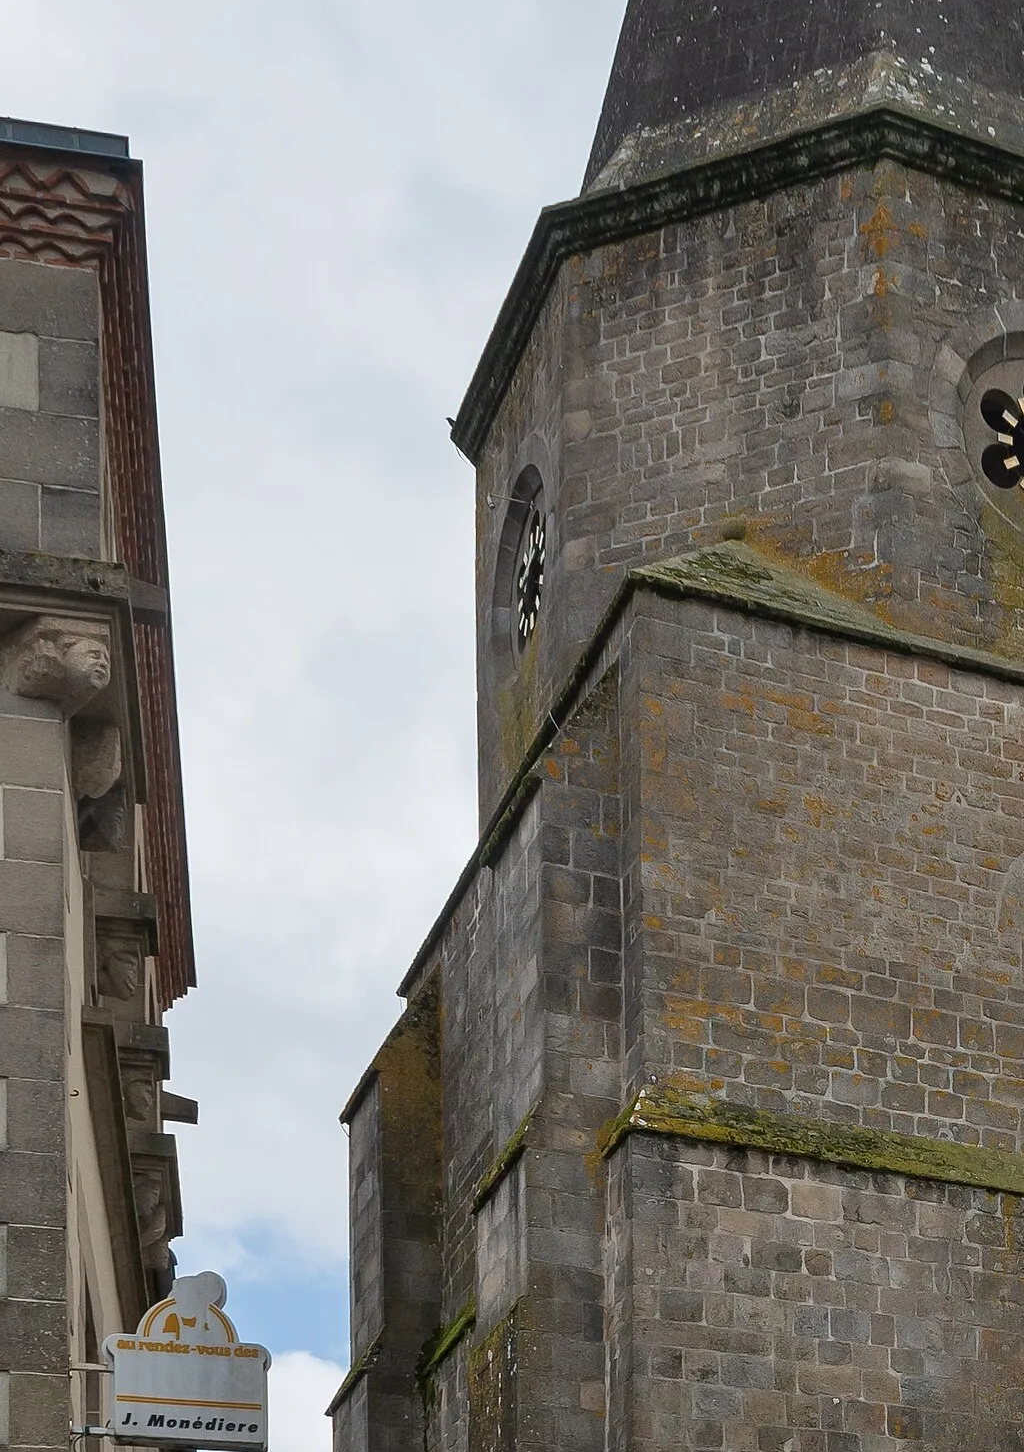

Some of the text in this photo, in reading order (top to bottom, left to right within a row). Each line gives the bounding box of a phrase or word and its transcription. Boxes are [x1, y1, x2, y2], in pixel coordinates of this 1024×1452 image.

[116, 1339, 259, 1358] au rendez-vous des
[122, 1412, 259, 1433] J. Monédiere
